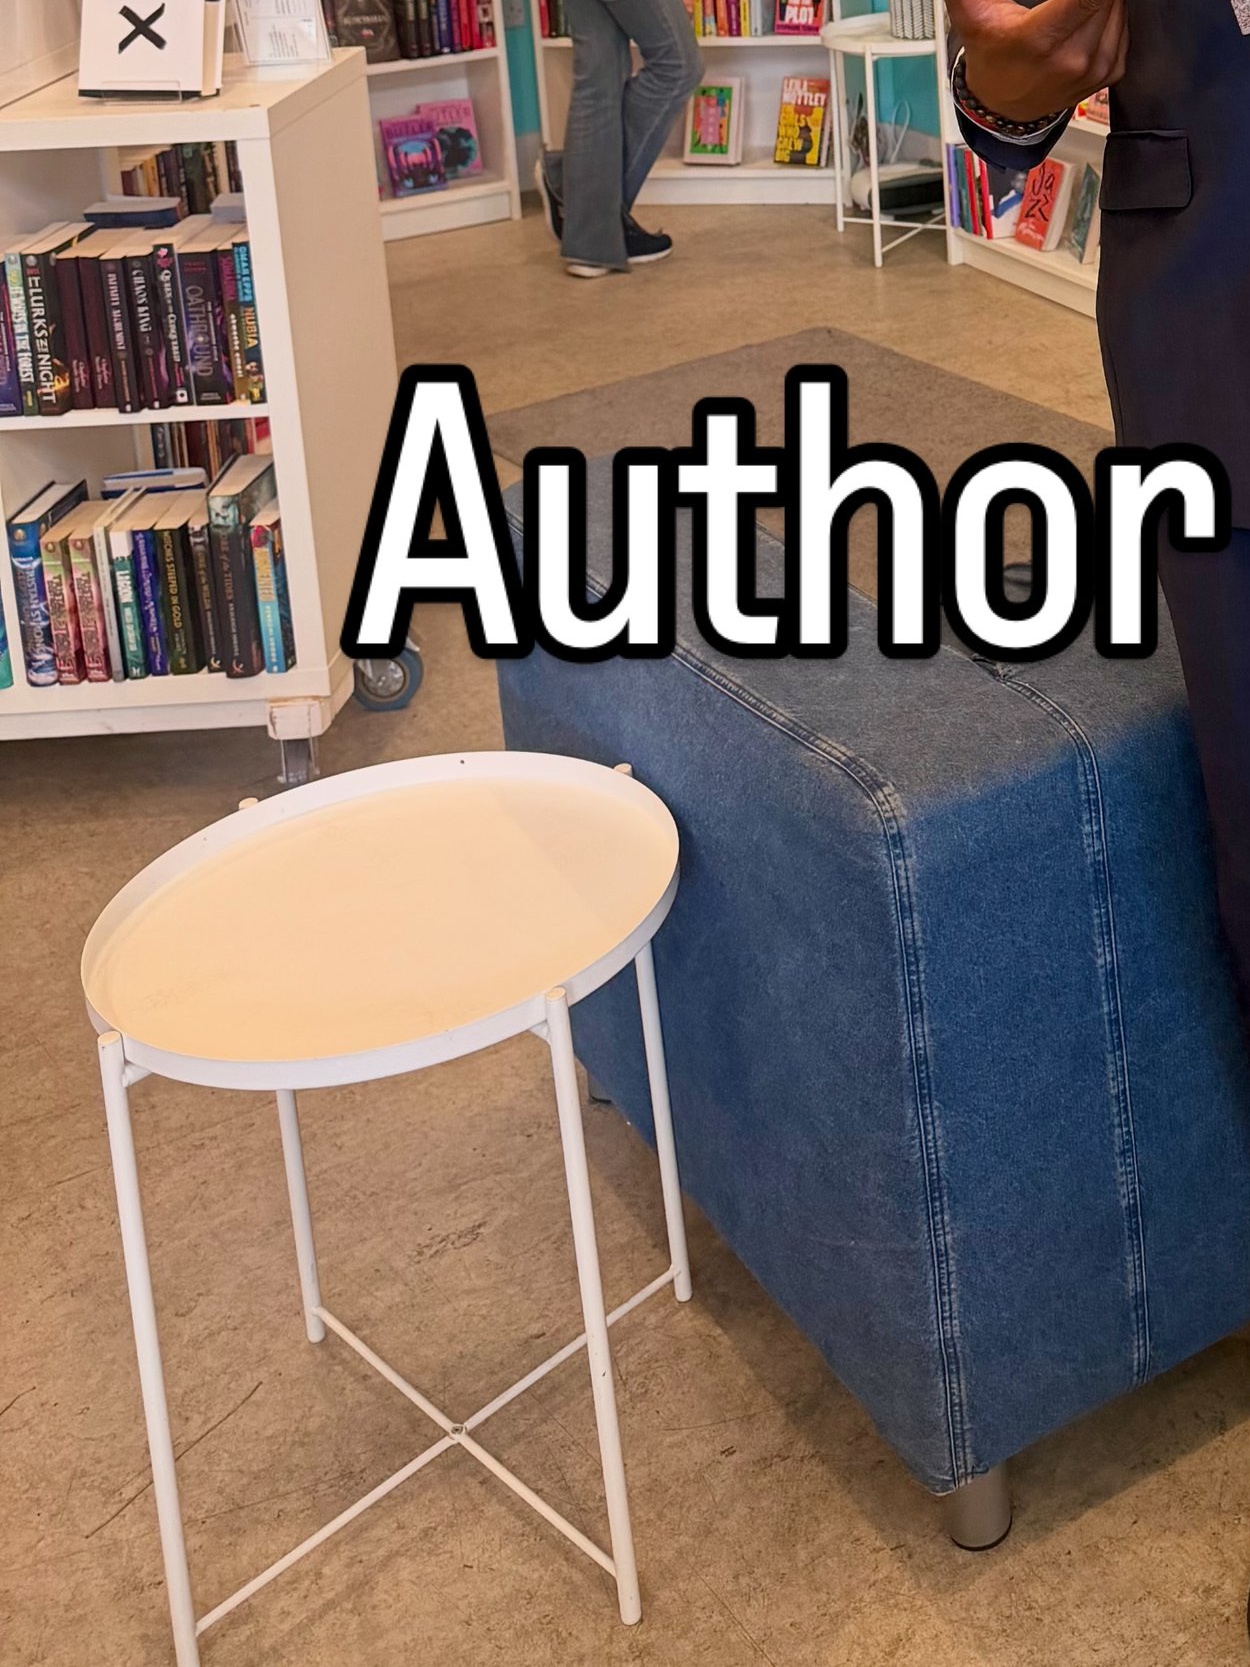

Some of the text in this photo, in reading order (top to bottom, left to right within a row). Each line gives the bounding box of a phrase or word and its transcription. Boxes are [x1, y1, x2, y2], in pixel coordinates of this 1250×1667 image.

[118, 2, 167, 54] X
[785, 7, 814, 24] PLOT
[239, 246, 252, 302] OMAR EPPS
[29, 287, 56, 404] LURKS NIGHT
[243, 307, 258, 348] NUBIA
[166, 563, 178, 595] STEEPED
[171, 595, 179, 605] IN
[172, 605, 183, 628] GOLD
